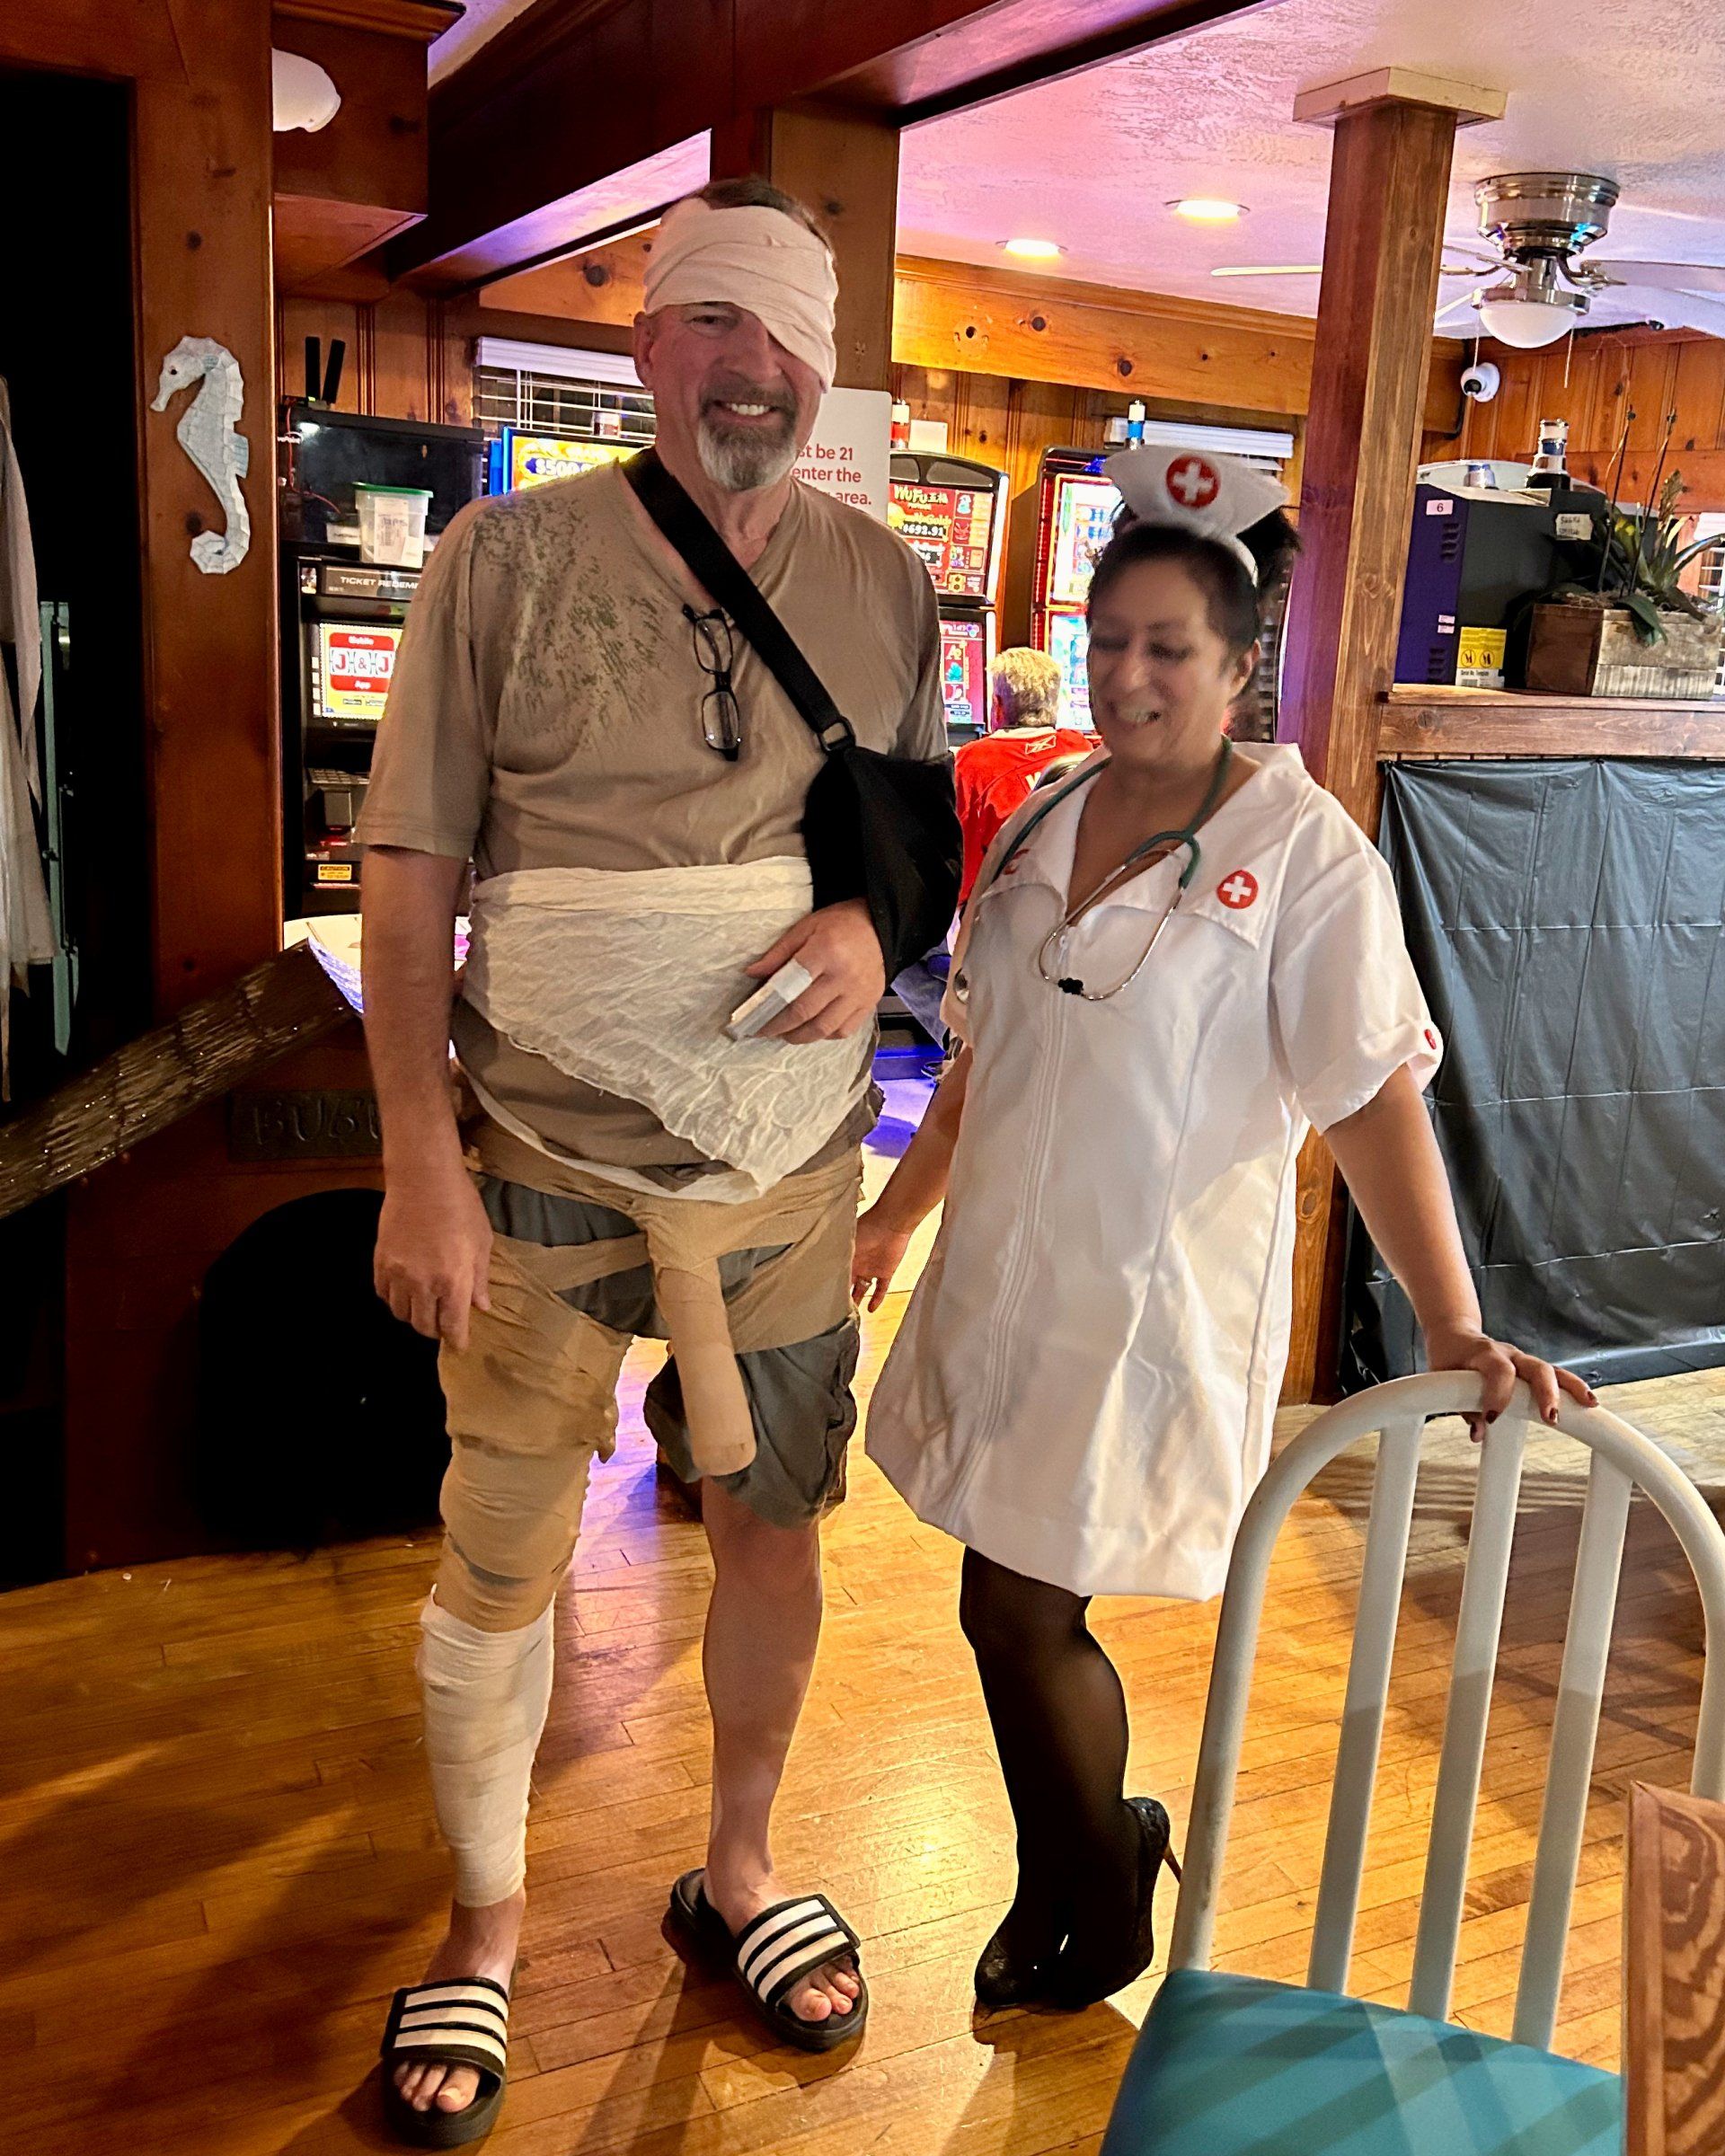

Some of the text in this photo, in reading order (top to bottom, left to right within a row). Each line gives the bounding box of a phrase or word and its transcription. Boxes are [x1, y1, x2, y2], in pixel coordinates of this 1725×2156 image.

[816, 443, 836, 459] be
[839, 446, 853, 461] 21
[792, 466, 862, 482] enter the
[836, 491, 871, 505] area.
[1437, 502, 1444, 513] 6
[340, 576, 376, 586] TICKET
[335, 654, 346, 670] J
[378, 657, 389, 673] J
